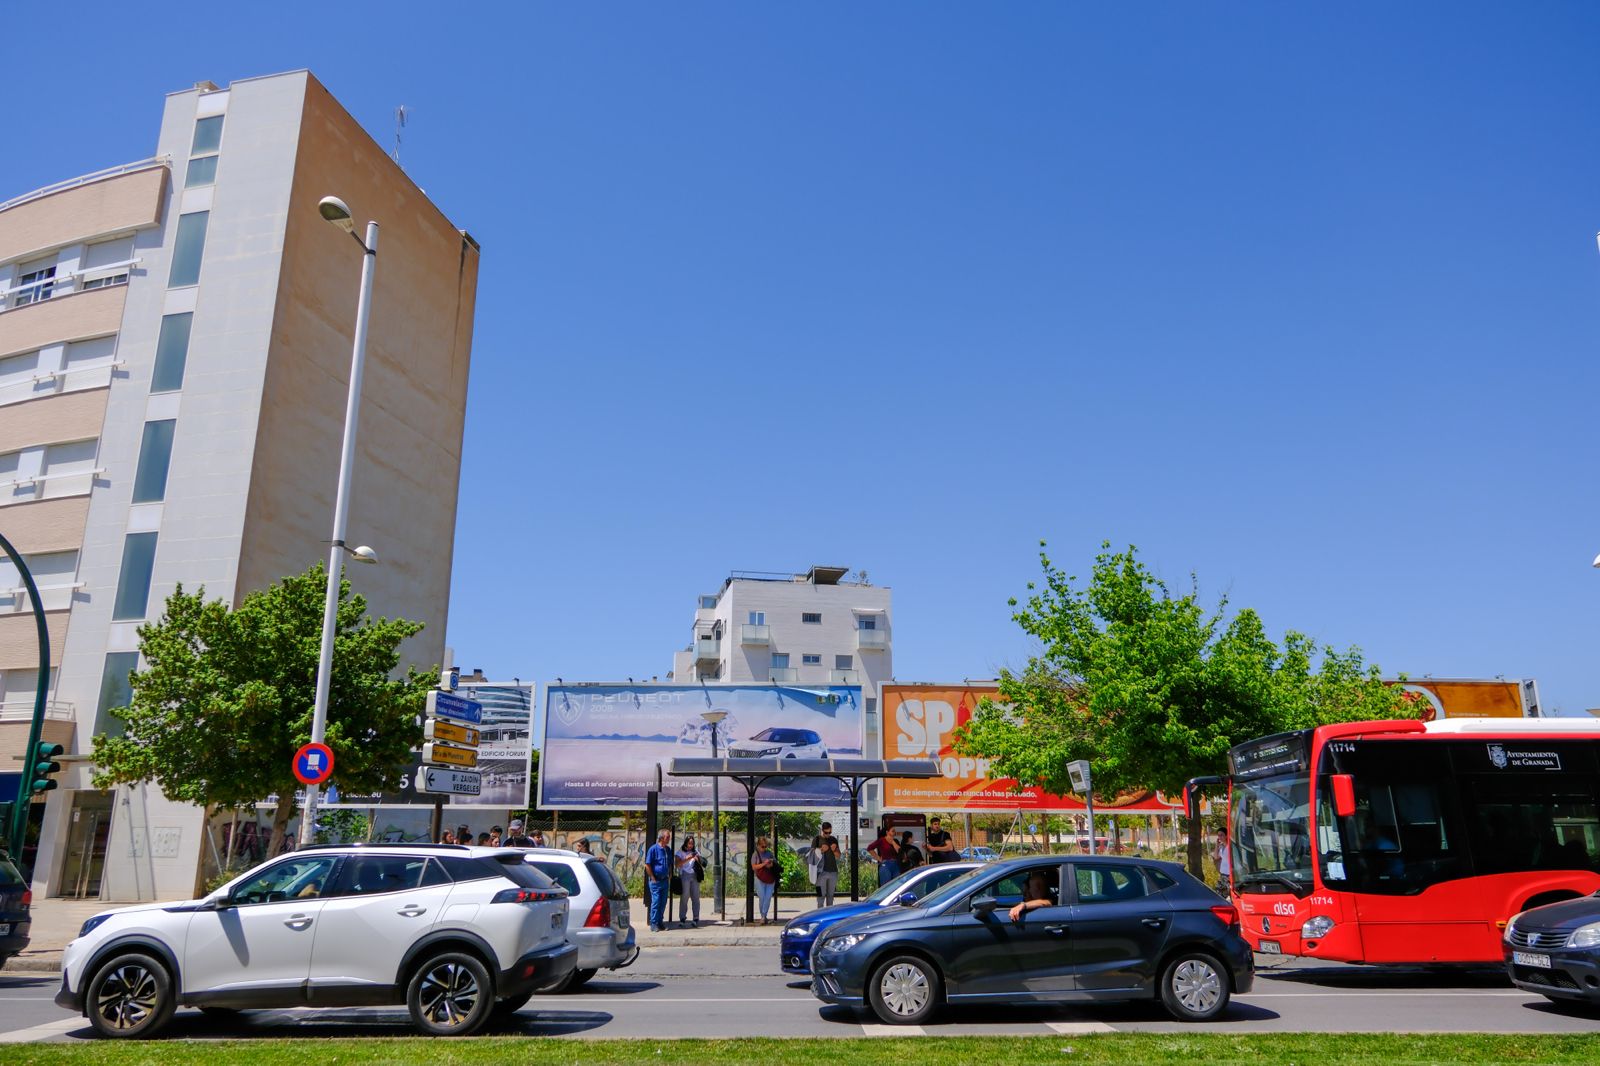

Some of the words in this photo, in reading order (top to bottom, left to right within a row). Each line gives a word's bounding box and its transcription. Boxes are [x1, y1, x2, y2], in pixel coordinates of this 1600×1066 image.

[1328, 743, 1356, 753] 11714
[1507, 750, 1556, 758] AYUNTAMIENTO
[1522, 758, 1554, 766] GRANADA
[453, 784, 480, 792] VERGELES
[901, 788, 911, 796] de
[984, 789, 991, 797] lo
[992, 789, 1005, 797] has
[1310, 897, 1333, 905] 11714
[1273, 901, 1295, 915] alsa
